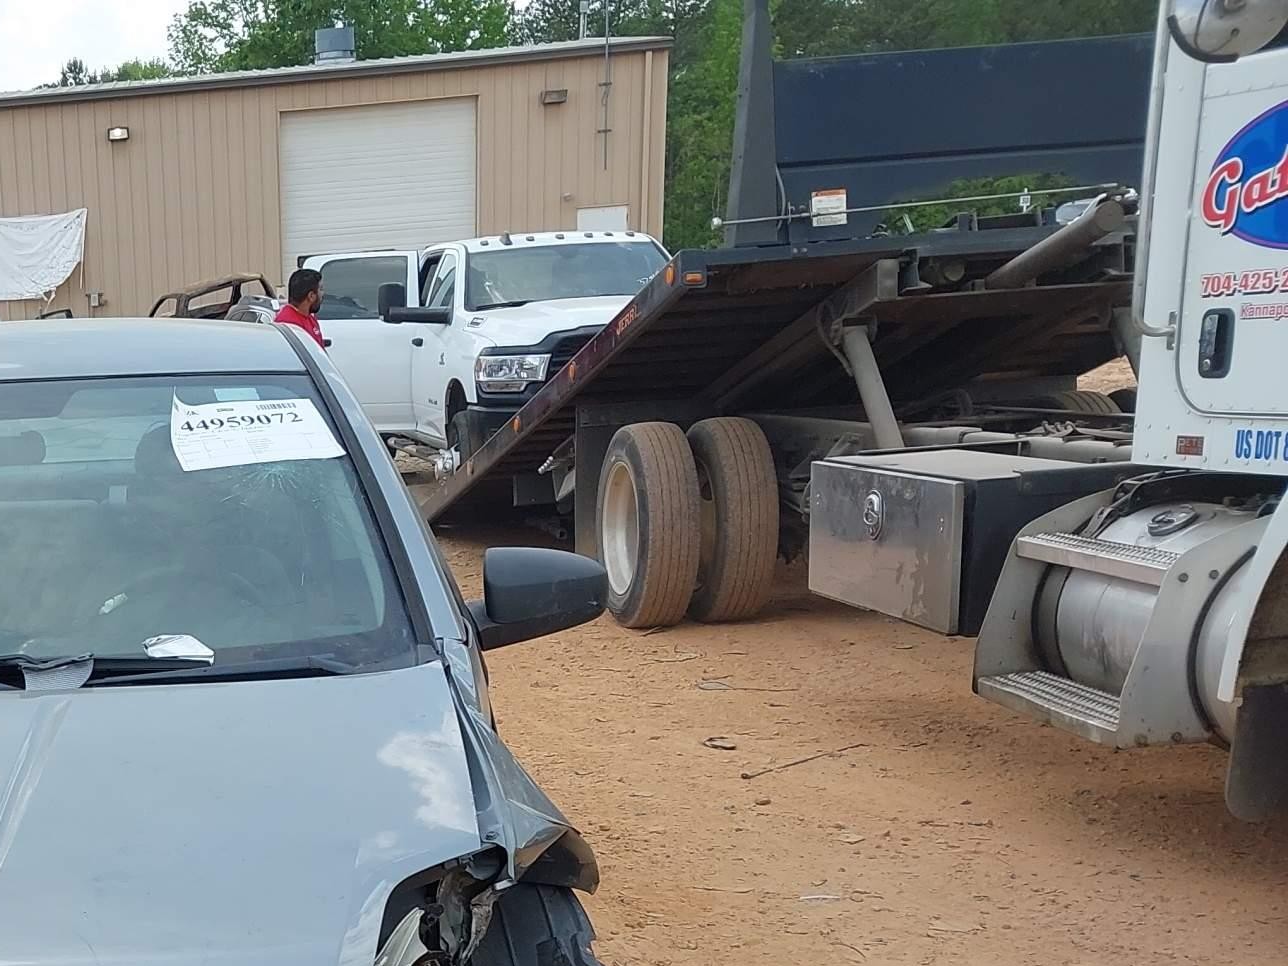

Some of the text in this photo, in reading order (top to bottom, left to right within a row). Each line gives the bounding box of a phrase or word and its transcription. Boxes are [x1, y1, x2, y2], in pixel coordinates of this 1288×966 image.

[180, 411, 304, 433] 44959072
[1235, 429, 1253, 459] US
[1254, 430, 1282, 460] DOT
